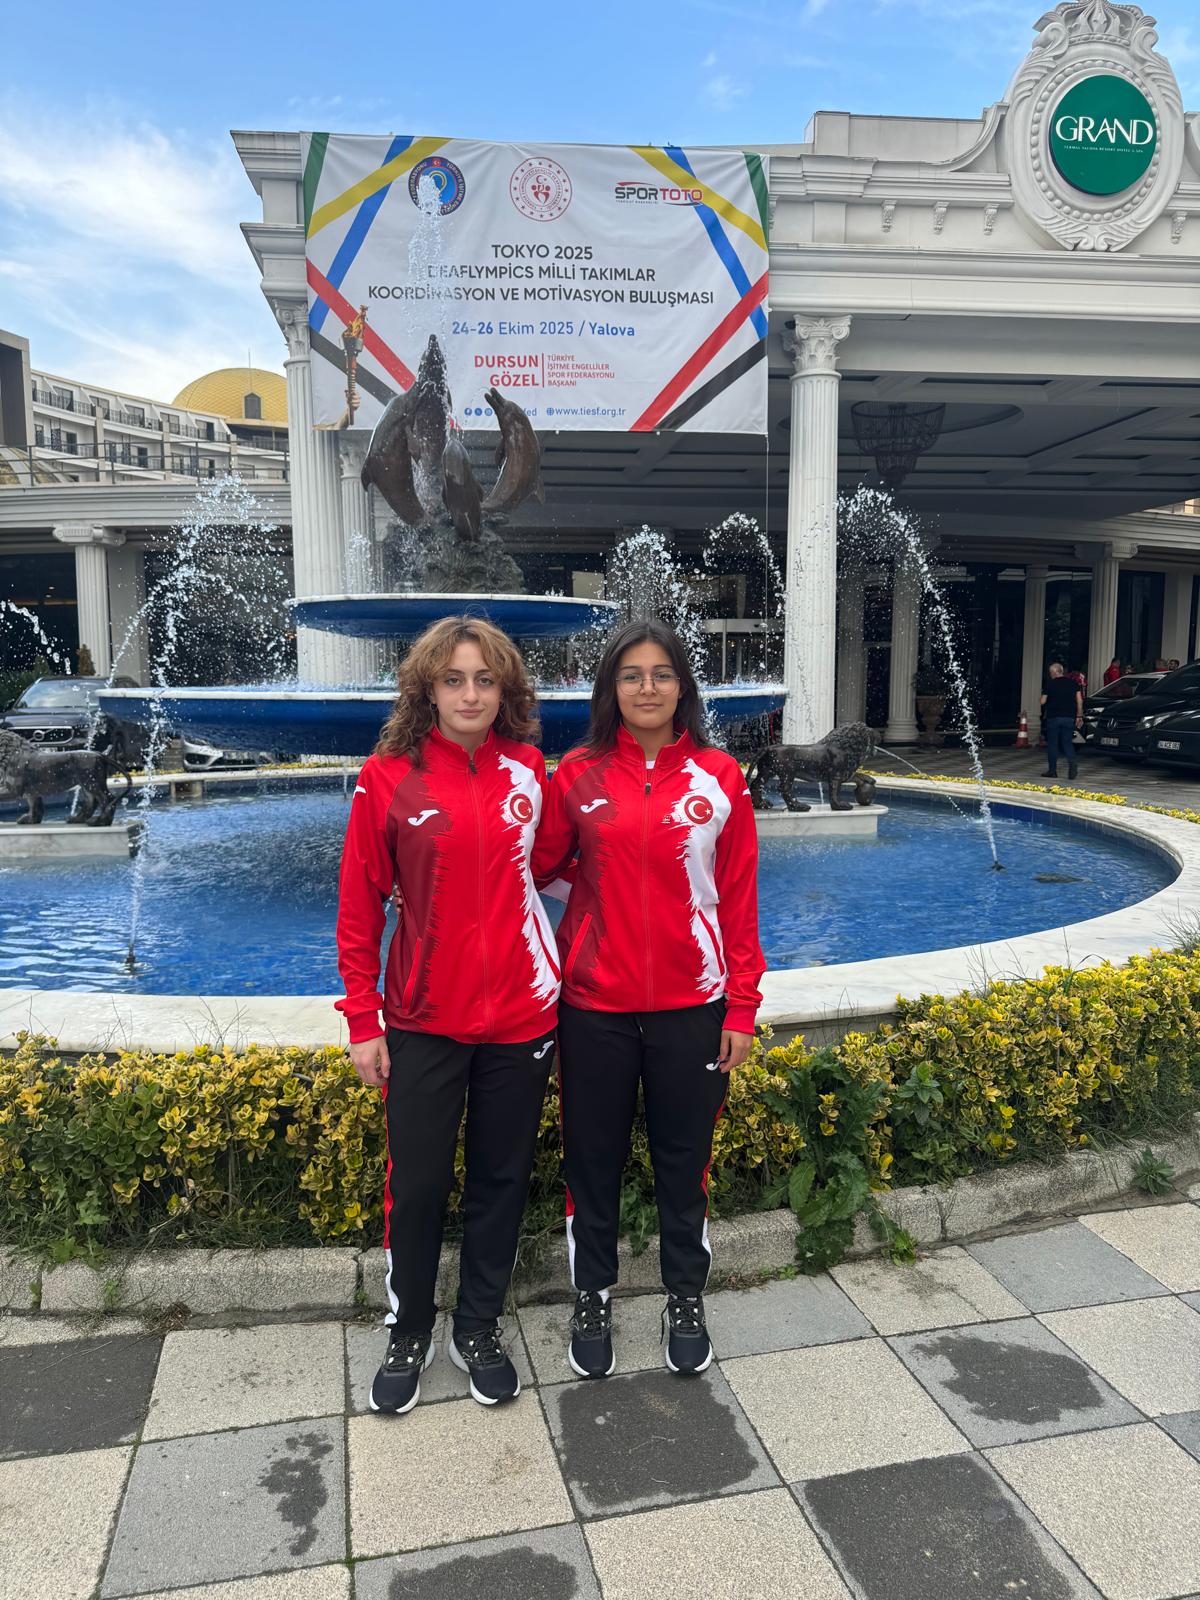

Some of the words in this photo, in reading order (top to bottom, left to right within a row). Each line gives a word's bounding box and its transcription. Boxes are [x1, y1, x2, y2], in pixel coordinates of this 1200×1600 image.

[1055, 115, 1154, 145] GRAND
[614, 186, 703, 201] SPORTOTO
[491, 244, 550, 259] TOKYO
[554, 245, 593, 260] 2025
[538, 262, 576, 280] MİLLİ
[580, 267, 656, 282] TAKIMLAR
[368, 283, 495, 301] KOORDİNASYON
[500, 287, 519, 301] VE
[524, 284, 625, 303] MOTİVASYON
[629, 290, 714, 308] BULUŞMASI
[452, 321, 494, 335] 24-26
[499, 321, 535, 335] Ekim
[540, 321, 574, 335] 2025
[578, 320, 585, 337] /
[589, 322, 636, 337] Yalova
[474, 355, 539, 368] DURSUN
[547, 353, 575, 361] TÜRKİYE
[489, 371, 540, 387] GÖZEL
[567, 371, 615, 379] FEDERASYONU
[547, 379, 577, 388] BAŞKANI
[556, 406, 627, 417] www.tiesf.org.tr
